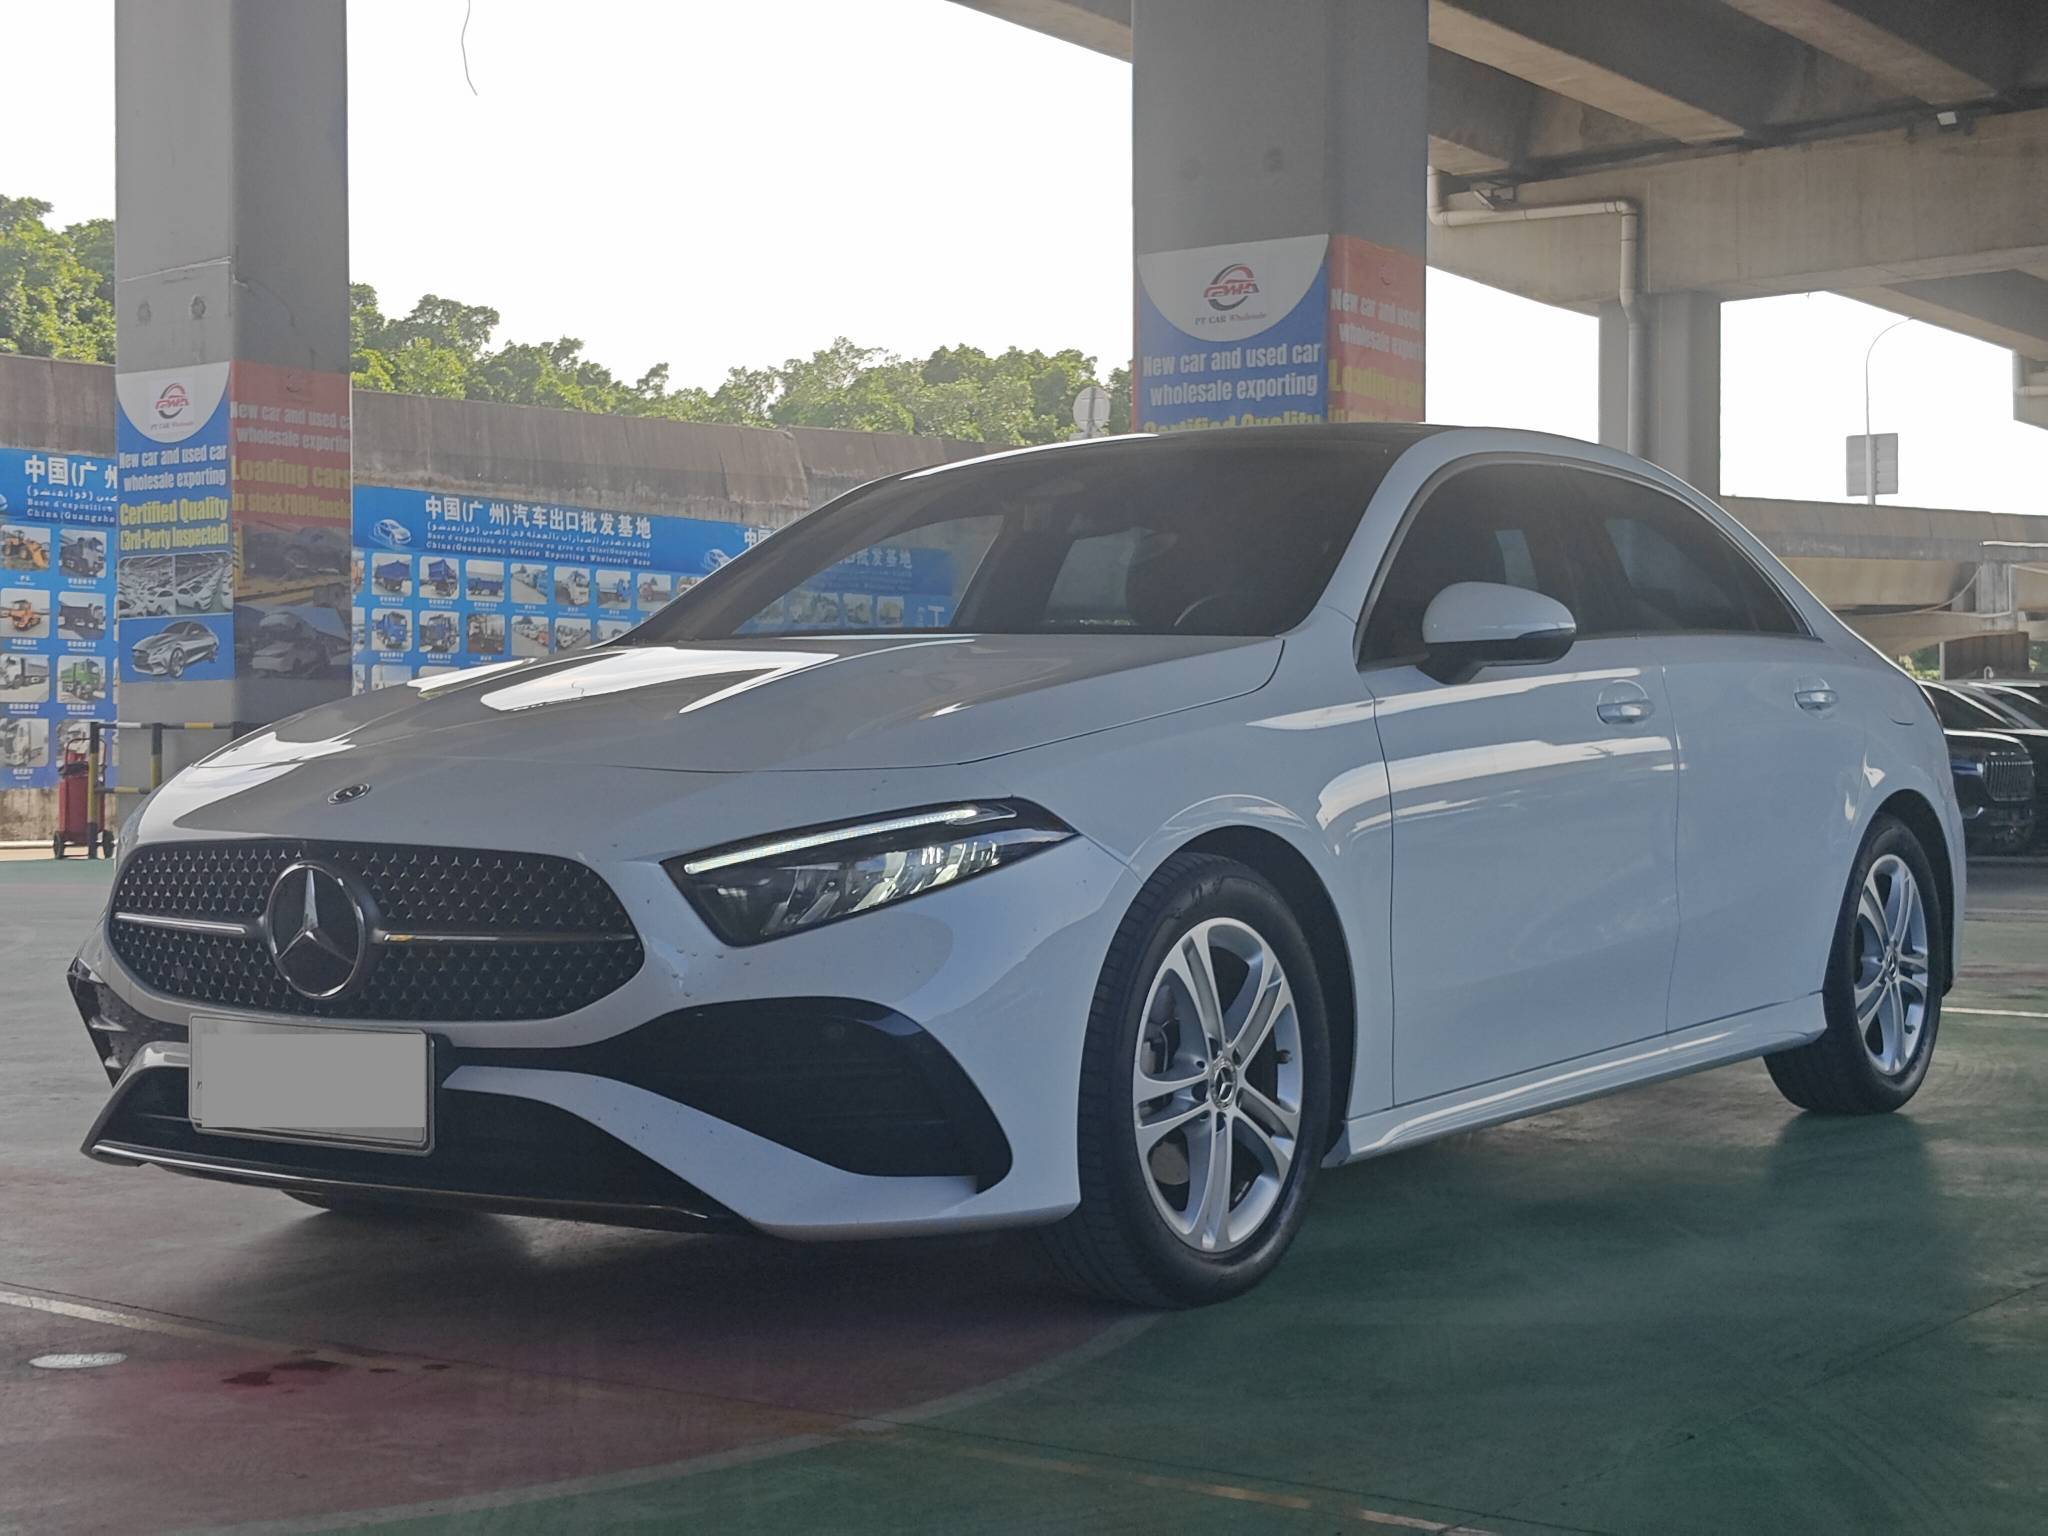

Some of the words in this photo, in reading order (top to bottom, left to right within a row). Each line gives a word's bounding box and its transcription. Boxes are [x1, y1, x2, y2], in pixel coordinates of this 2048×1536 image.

[1143, 355, 1175, 378] New
[1180, 352, 1207, 374] car
[1211, 348, 1241, 372] and
[1246, 344, 1288, 368] used
[1292, 343, 1321, 365] car
[1150, 380, 1233, 407] wholesale
[1236, 372, 1318, 401] exporting
[262, 406, 280, 422] car
[284, 408, 306, 425] and
[308, 410, 337, 429] used
[237, 427, 300, 448] wholesale
[302, 433, 350, 454] exportin
[119, 452, 139, 469] New
[142, 451, 158, 467] car
[160, 448, 180, 465] and
[182, 445, 207, 462] used
[209, 445, 227, 461] car
[124, 472, 175, 492] wholesale
[177, 467, 227, 489] exporting
[231, 455, 308, 489] Loading
[120, 499, 178, 526] Certified
[179, 496, 228, 523] Quality
